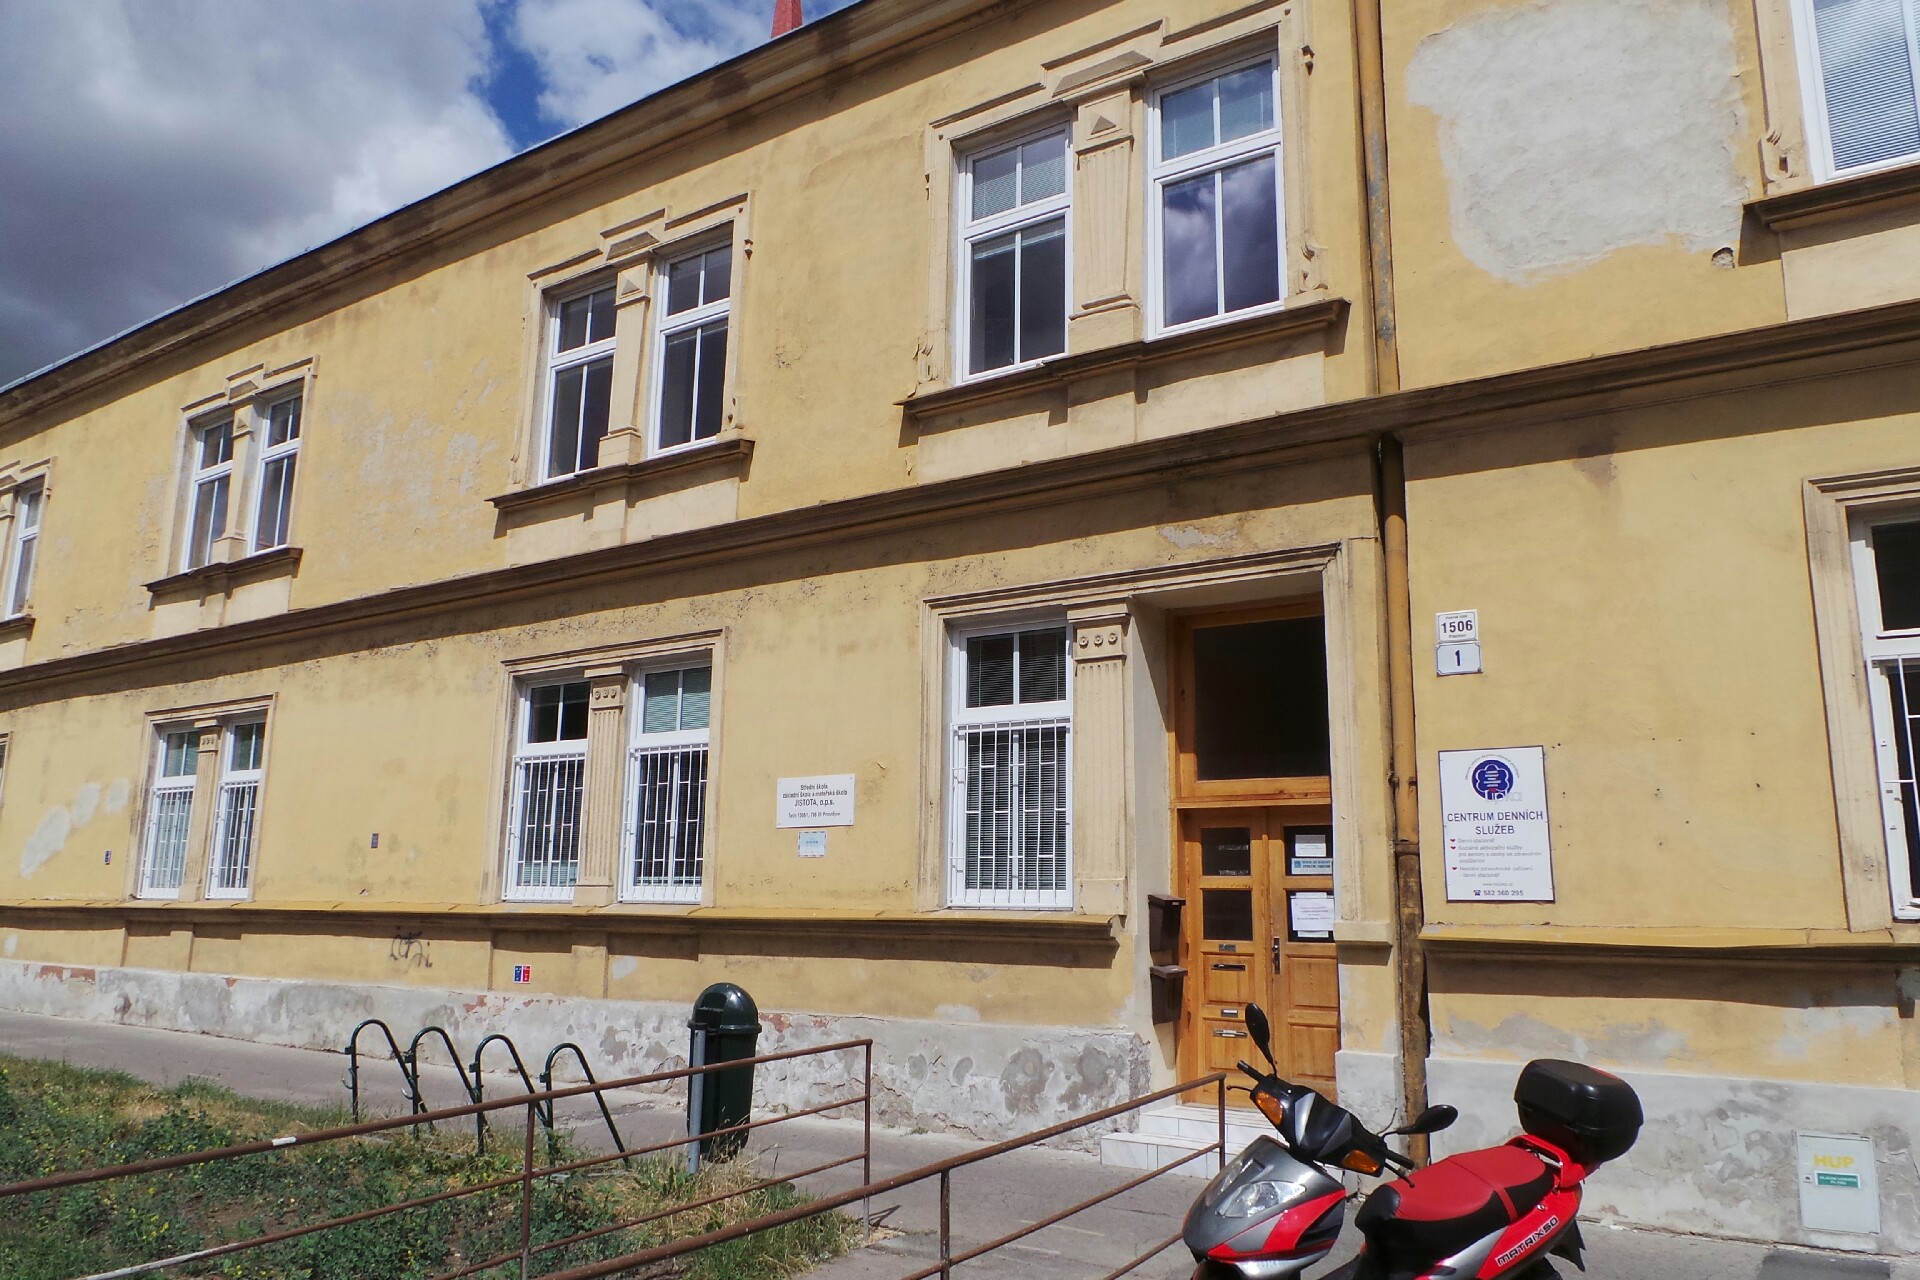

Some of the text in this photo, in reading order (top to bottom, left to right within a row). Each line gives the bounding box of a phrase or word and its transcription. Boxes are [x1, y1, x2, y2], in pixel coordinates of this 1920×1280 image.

[1441, 620, 1472, 633] 1506
[1455, 650, 1460, 666] 1
[794, 798, 818, 806] JISTOTA,
[1447, 809, 1543, 822] CENTRUM DENNÍCH
[1475, 824, 1515, 835] SLUŽEB
[1813, 1155, 1854, 1168] HUP
